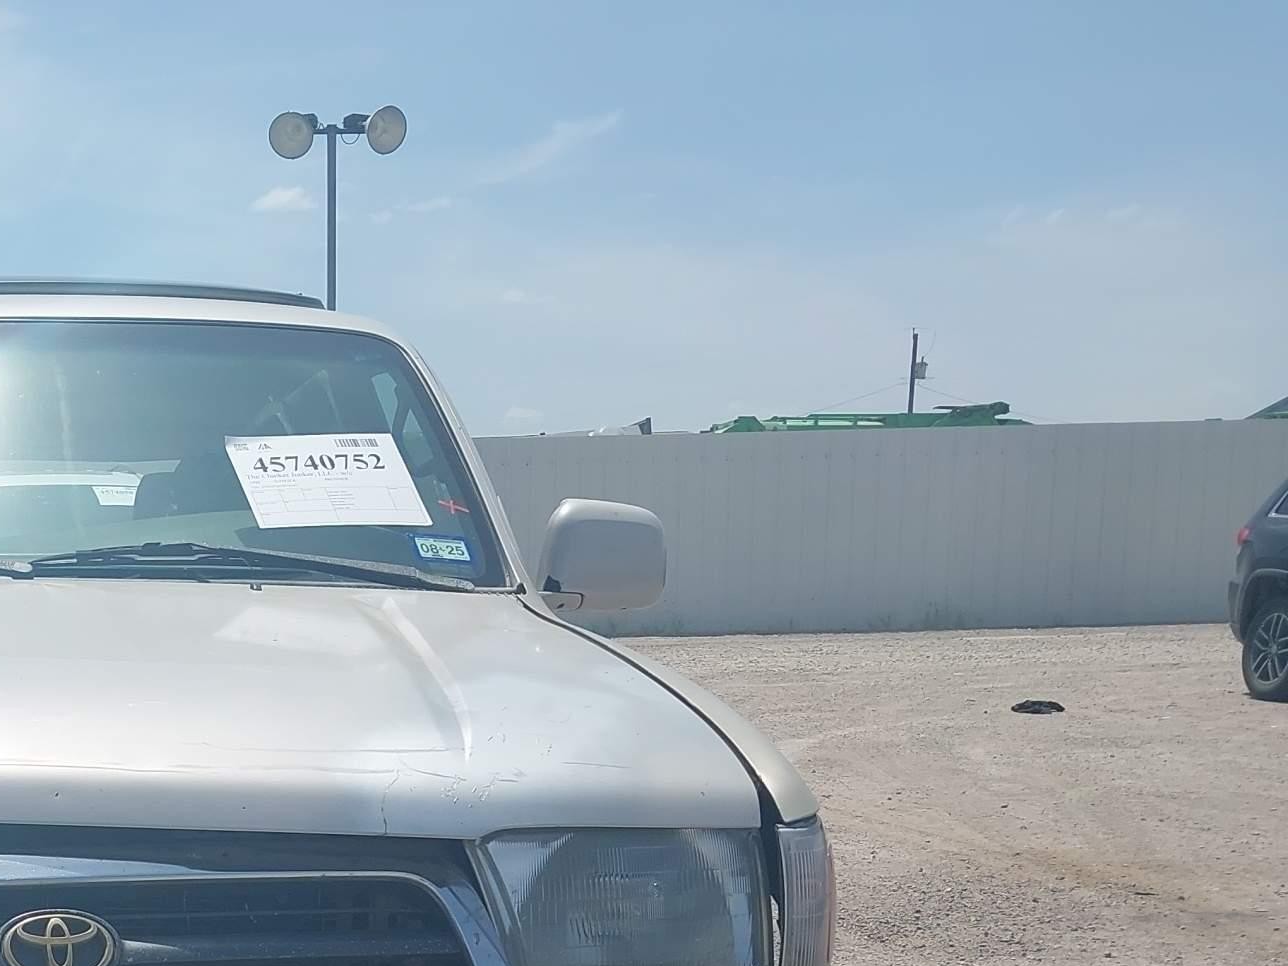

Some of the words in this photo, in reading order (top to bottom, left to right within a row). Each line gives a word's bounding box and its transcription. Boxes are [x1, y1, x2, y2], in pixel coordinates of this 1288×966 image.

[253, 453, 386, 473] 45740752
[419, 542, 440, 554] 08
[445, 544, 466, 556] 25
